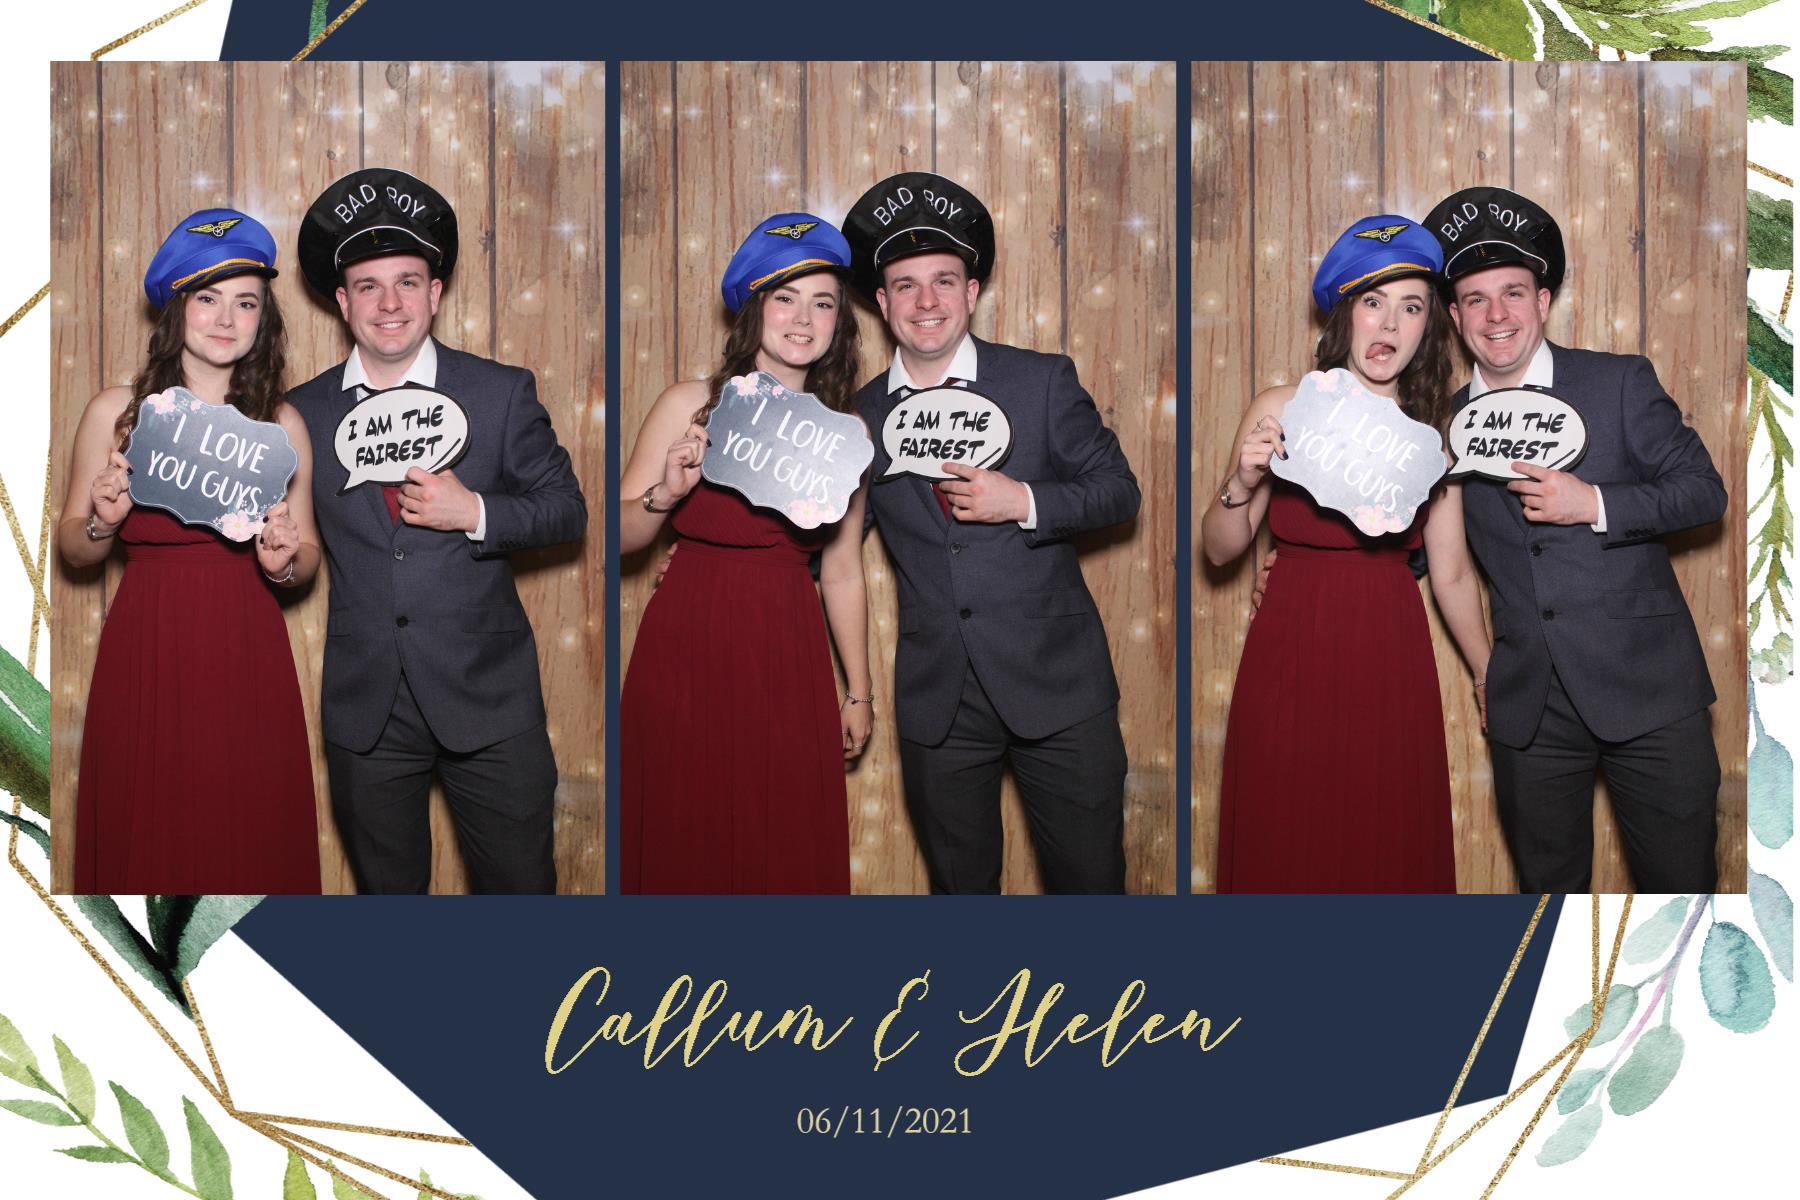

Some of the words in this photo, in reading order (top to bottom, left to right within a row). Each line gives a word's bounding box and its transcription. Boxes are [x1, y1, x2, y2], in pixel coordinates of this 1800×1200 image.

[334, 184, 377, 224] BAD
[873, 187, 914, 226] BAD
[1440, 202, 1479, 242] BAD
[348, 420, 358, 441] I
[366, 414, 392, 437] AM
[401, 405, 444, 428] THE
[751, 398, 768, 426] I
[776, 410, 847, 463] LOVE
[896, 410, 908, 430] I
[912, 410, 940, 430] AM
[949, 411, 992, 432] THE
[1326, 397, 1347, 424] I
[1351, 412, 1420, 473] LOVE
[1464, 410, 1478, 429] I
[1482, 410, 1512, 430] AM
[1522, 412, 1567, 434] THE
[173, 414, 187, 444] I
[200, 424, 270, 475] LOVE
[356, 435, 443, 468] FAIREST
[899, 438, 986, 460] FAIREST
[1466, 437, 1559, 460] FAIREST
[148, 450, 198, 490] YOU
[201, 470, 263, 516] GUYS
[722, 430, 772, 472] YOU
[773, 456, 834, 504] GUYS
[1293, 426, 1345, 472] YOU
[1343, 459, 1404, 513] GUYS
